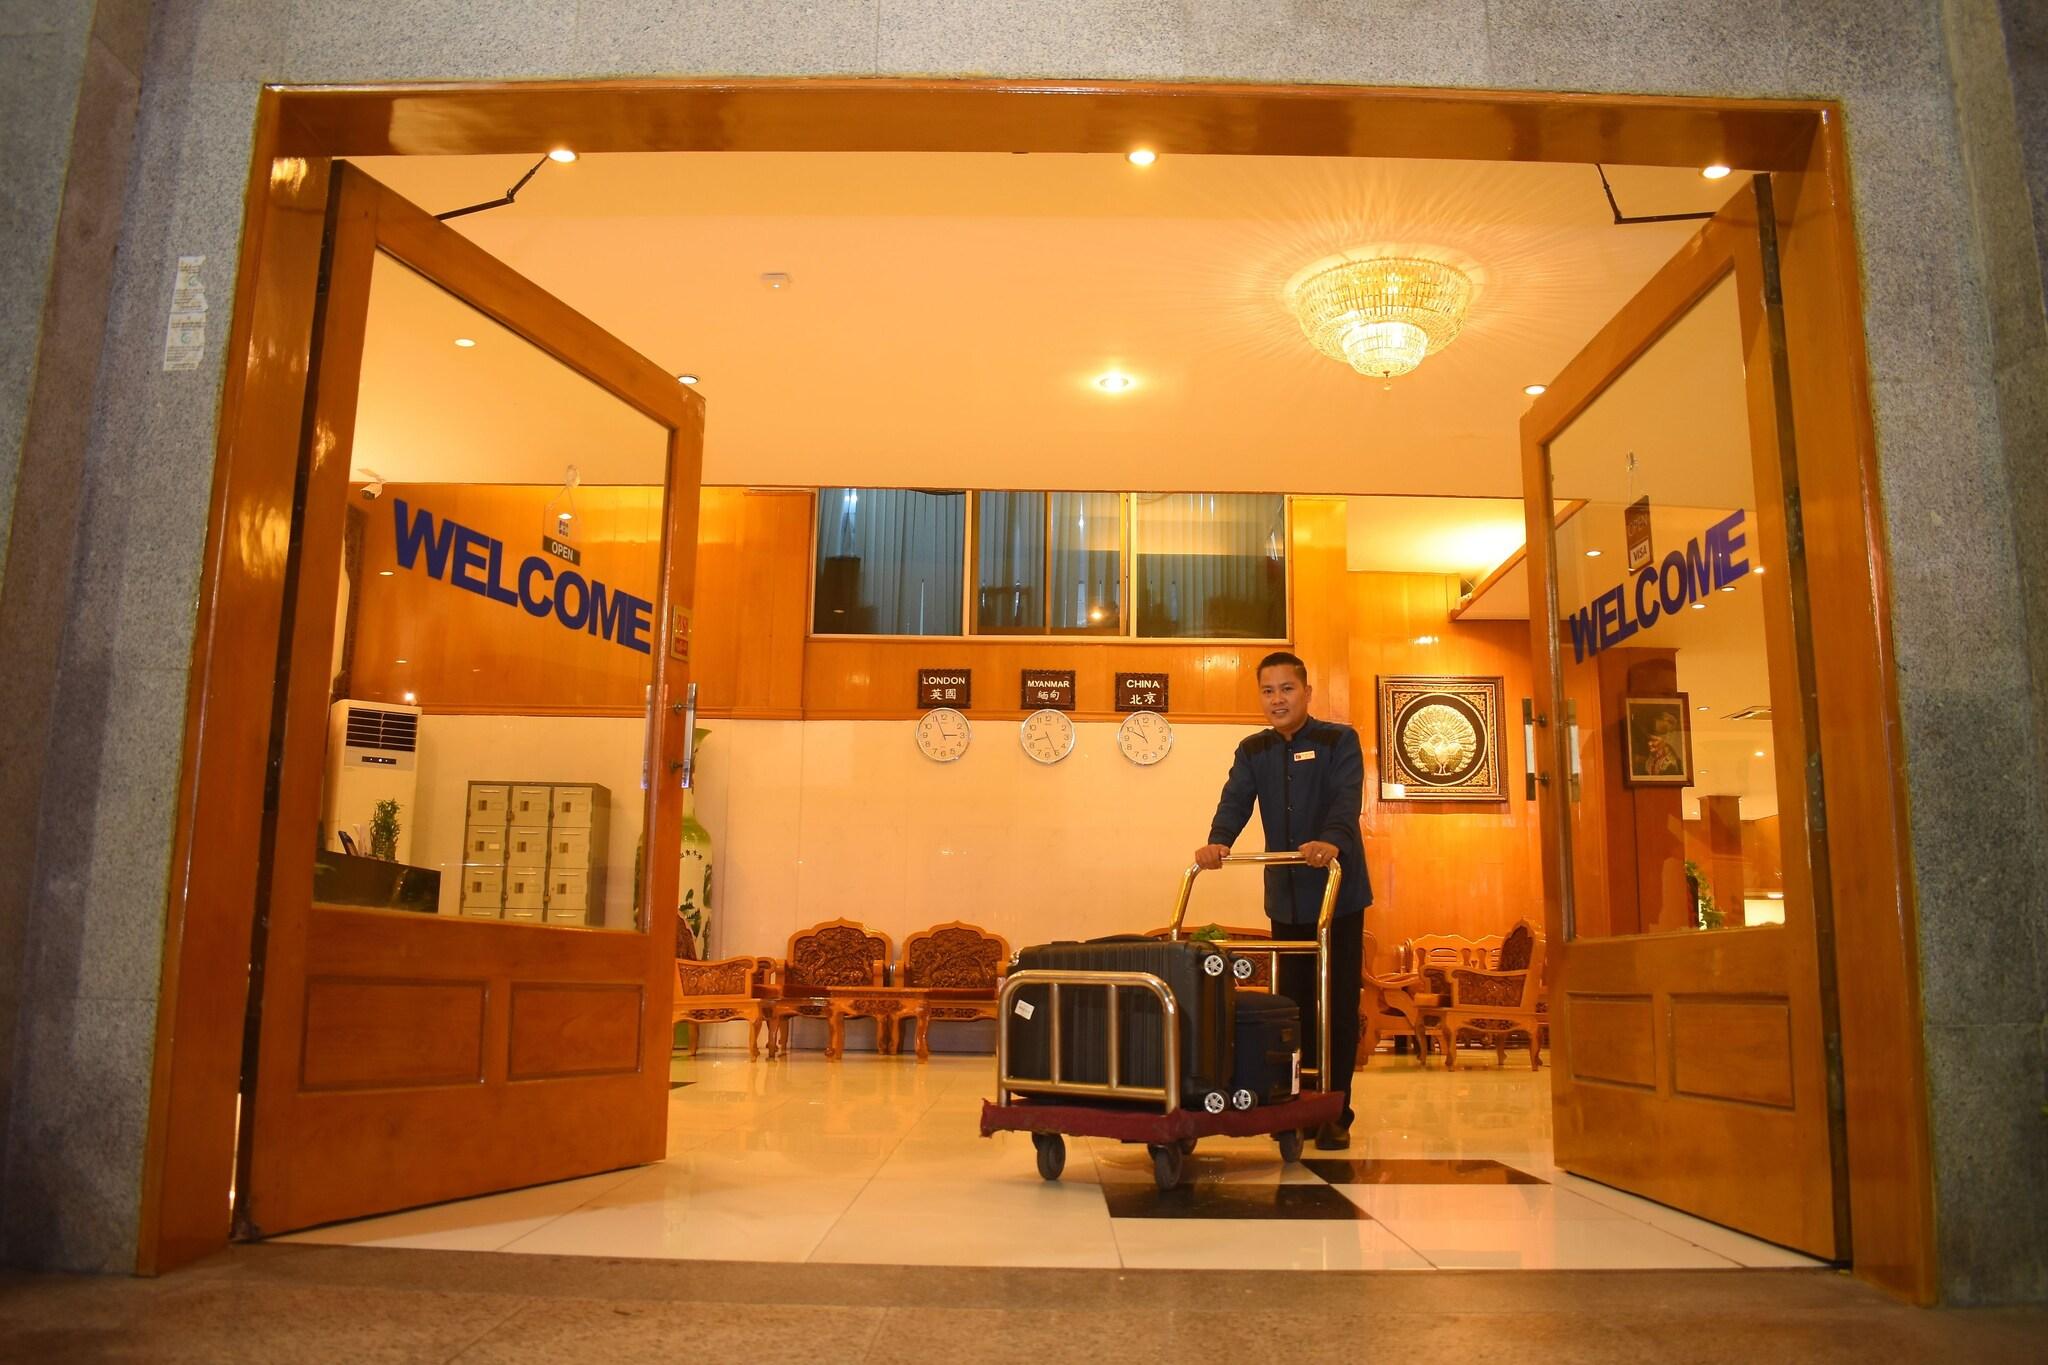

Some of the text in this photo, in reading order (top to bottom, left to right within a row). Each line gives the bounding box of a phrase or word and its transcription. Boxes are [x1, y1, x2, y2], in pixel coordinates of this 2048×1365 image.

[551, 541, 574, 561] OPEN
[1633, 544, 1647, 561] VISA
[394, 498, 653, 655] WELCOME
[1569, 508, 1750, 664] WELCOME
[923, 676, 966, 685] LONDON
[1027, 680, 1070, 688] MYANMAR
[1126, 679, 1160, 689] CHINA
[930, 688, 957, 700] 英國
[1129, 691, 1157, 705] 北京
